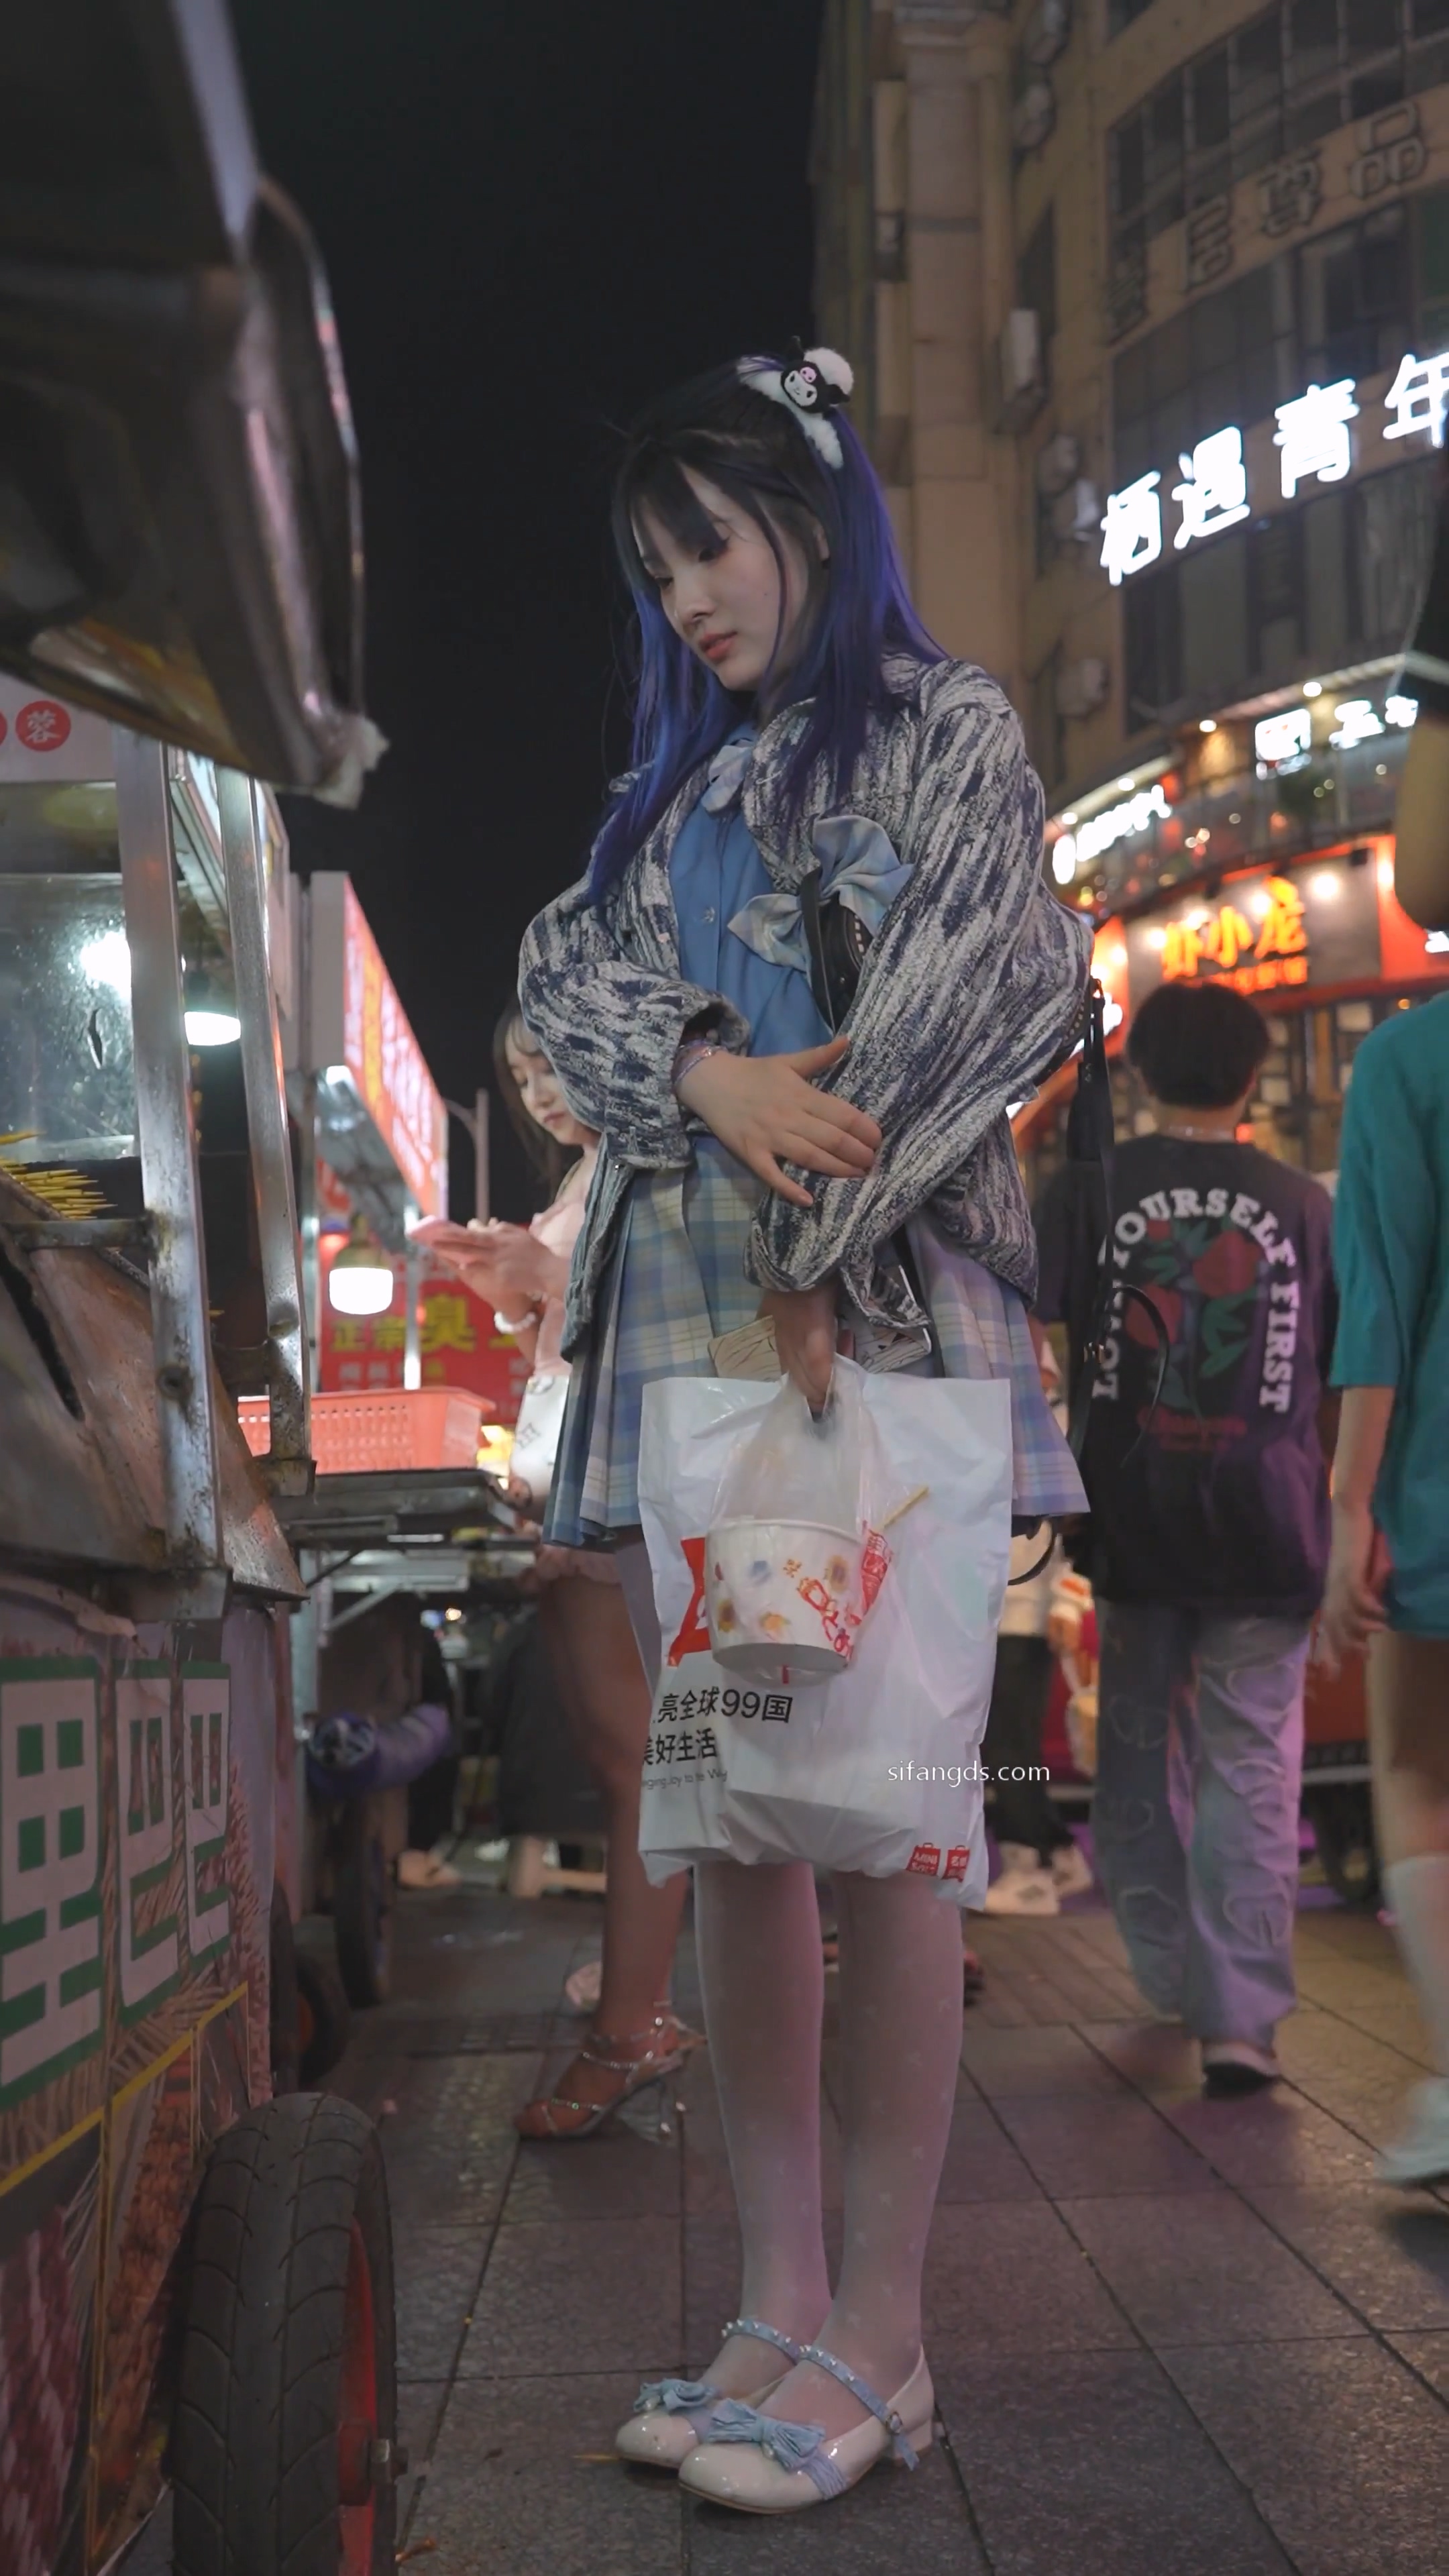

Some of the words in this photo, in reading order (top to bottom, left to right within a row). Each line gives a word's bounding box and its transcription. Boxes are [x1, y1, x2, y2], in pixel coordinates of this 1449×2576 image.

[1097, 1188, 1296, 1268] YOURSELF
[1259, 1280, 1301, 1413] FIRST
[653, 1686, 794, 1723] 亮全球99国
